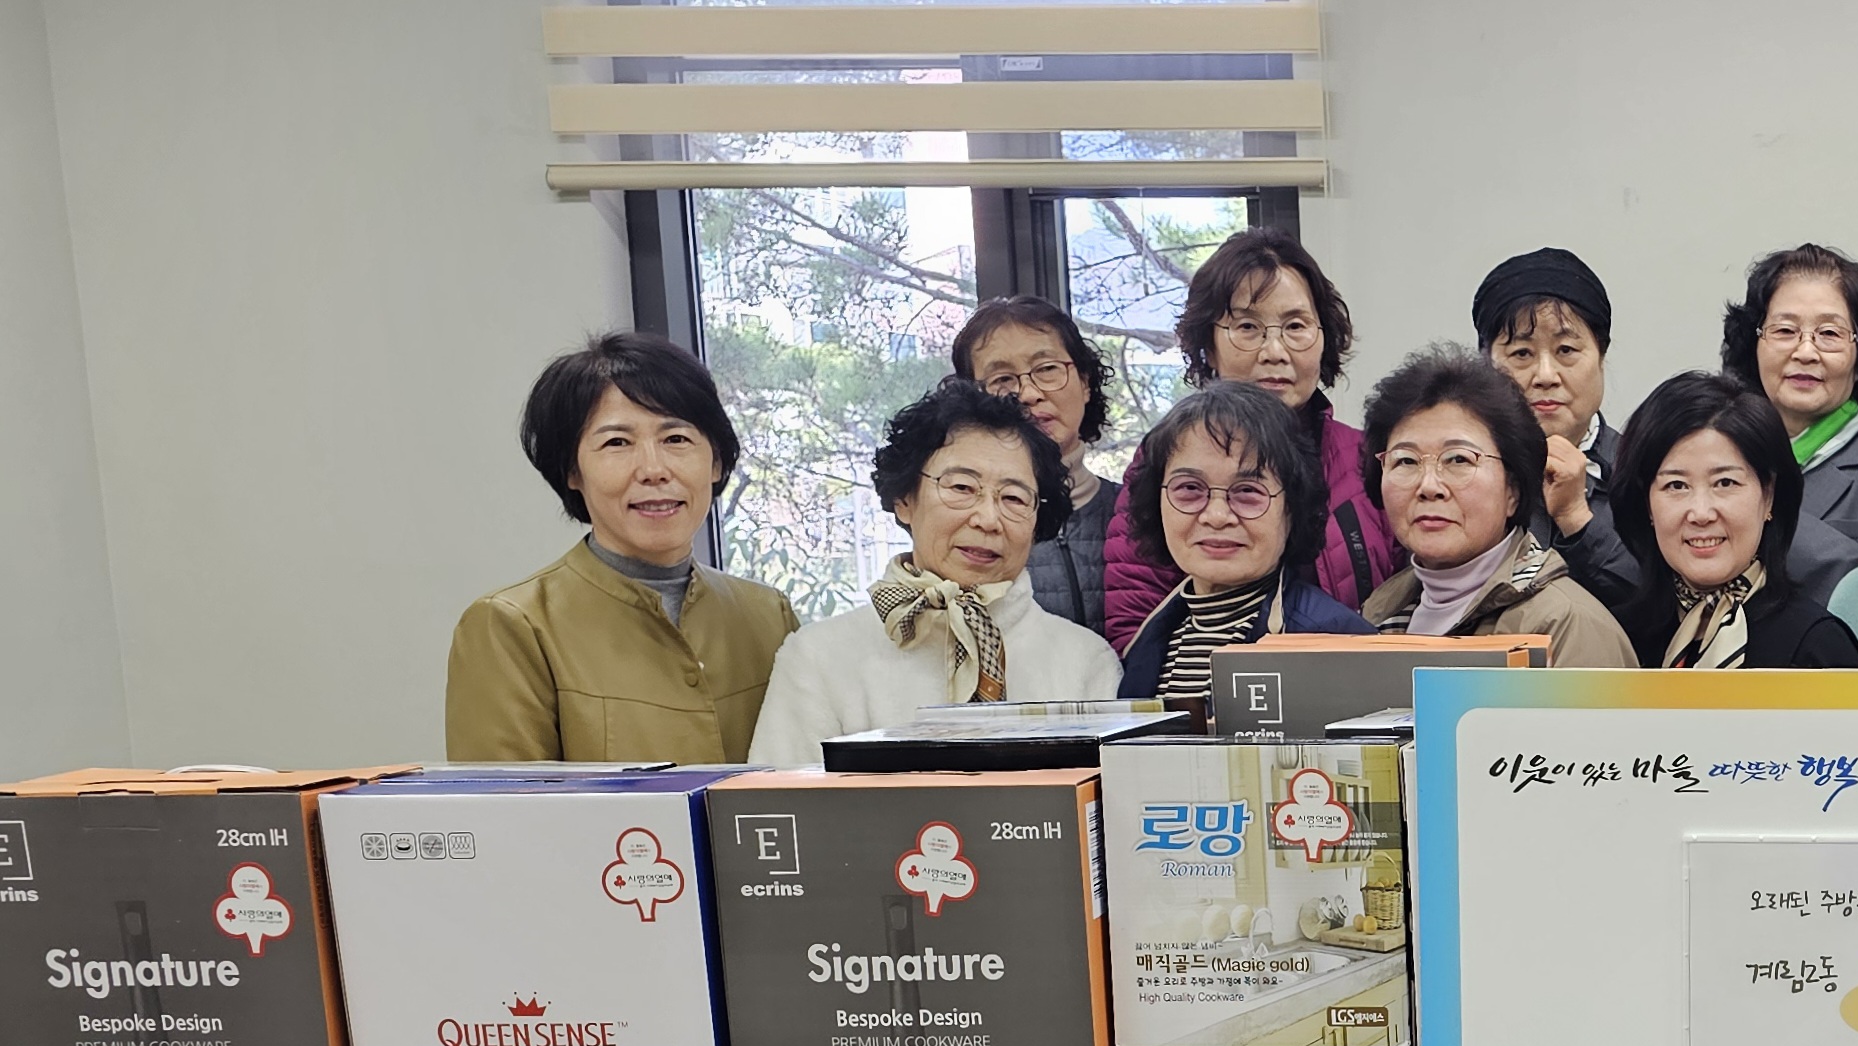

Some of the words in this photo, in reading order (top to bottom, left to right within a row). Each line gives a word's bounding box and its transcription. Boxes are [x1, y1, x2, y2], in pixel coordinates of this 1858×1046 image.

[1489, 753, 1575, 793] 이웃이
[1582, 762, 1623, 783] 있는
[1632, 753, 1709, 793] 마을
[1709, 760, 1791, 784] 따뜻한
[216, 828, 267, 847] 28cm
[269, 828, 289, 847] IH
[990, 821, 1041, 841] 28cm
[1043, 821, 1062, 840] IH
[1135, 798, 1255, 858] 로망
[1161, 859, 1236, 879] Roman
[740, 880, 805, 897] ecrins
[1750, 889, 1811, 913] 오래된
[45, 948, 241, 999] Signature
[807, 942, 1005, 994] Signature
[1136, 954, 1208, 973] 매직골드
[1211, 957, 1266, 973] (Magic
[1269, 957, 1310, 973] gold)
[1745, 957, 1839, 993] 계림2동
[1139, 992, 1161, 1004] High
[1163, 992, 1195, 1004] Quality
[1197, 992, 1245, 1002] Cookware
[78, 1013, 157, 1035] Bespoke
[160, 1013, 223, 1035] Design
[836, 1008, 914, 1030] Bespoke
[918, 1007, 983, 1029] Design
